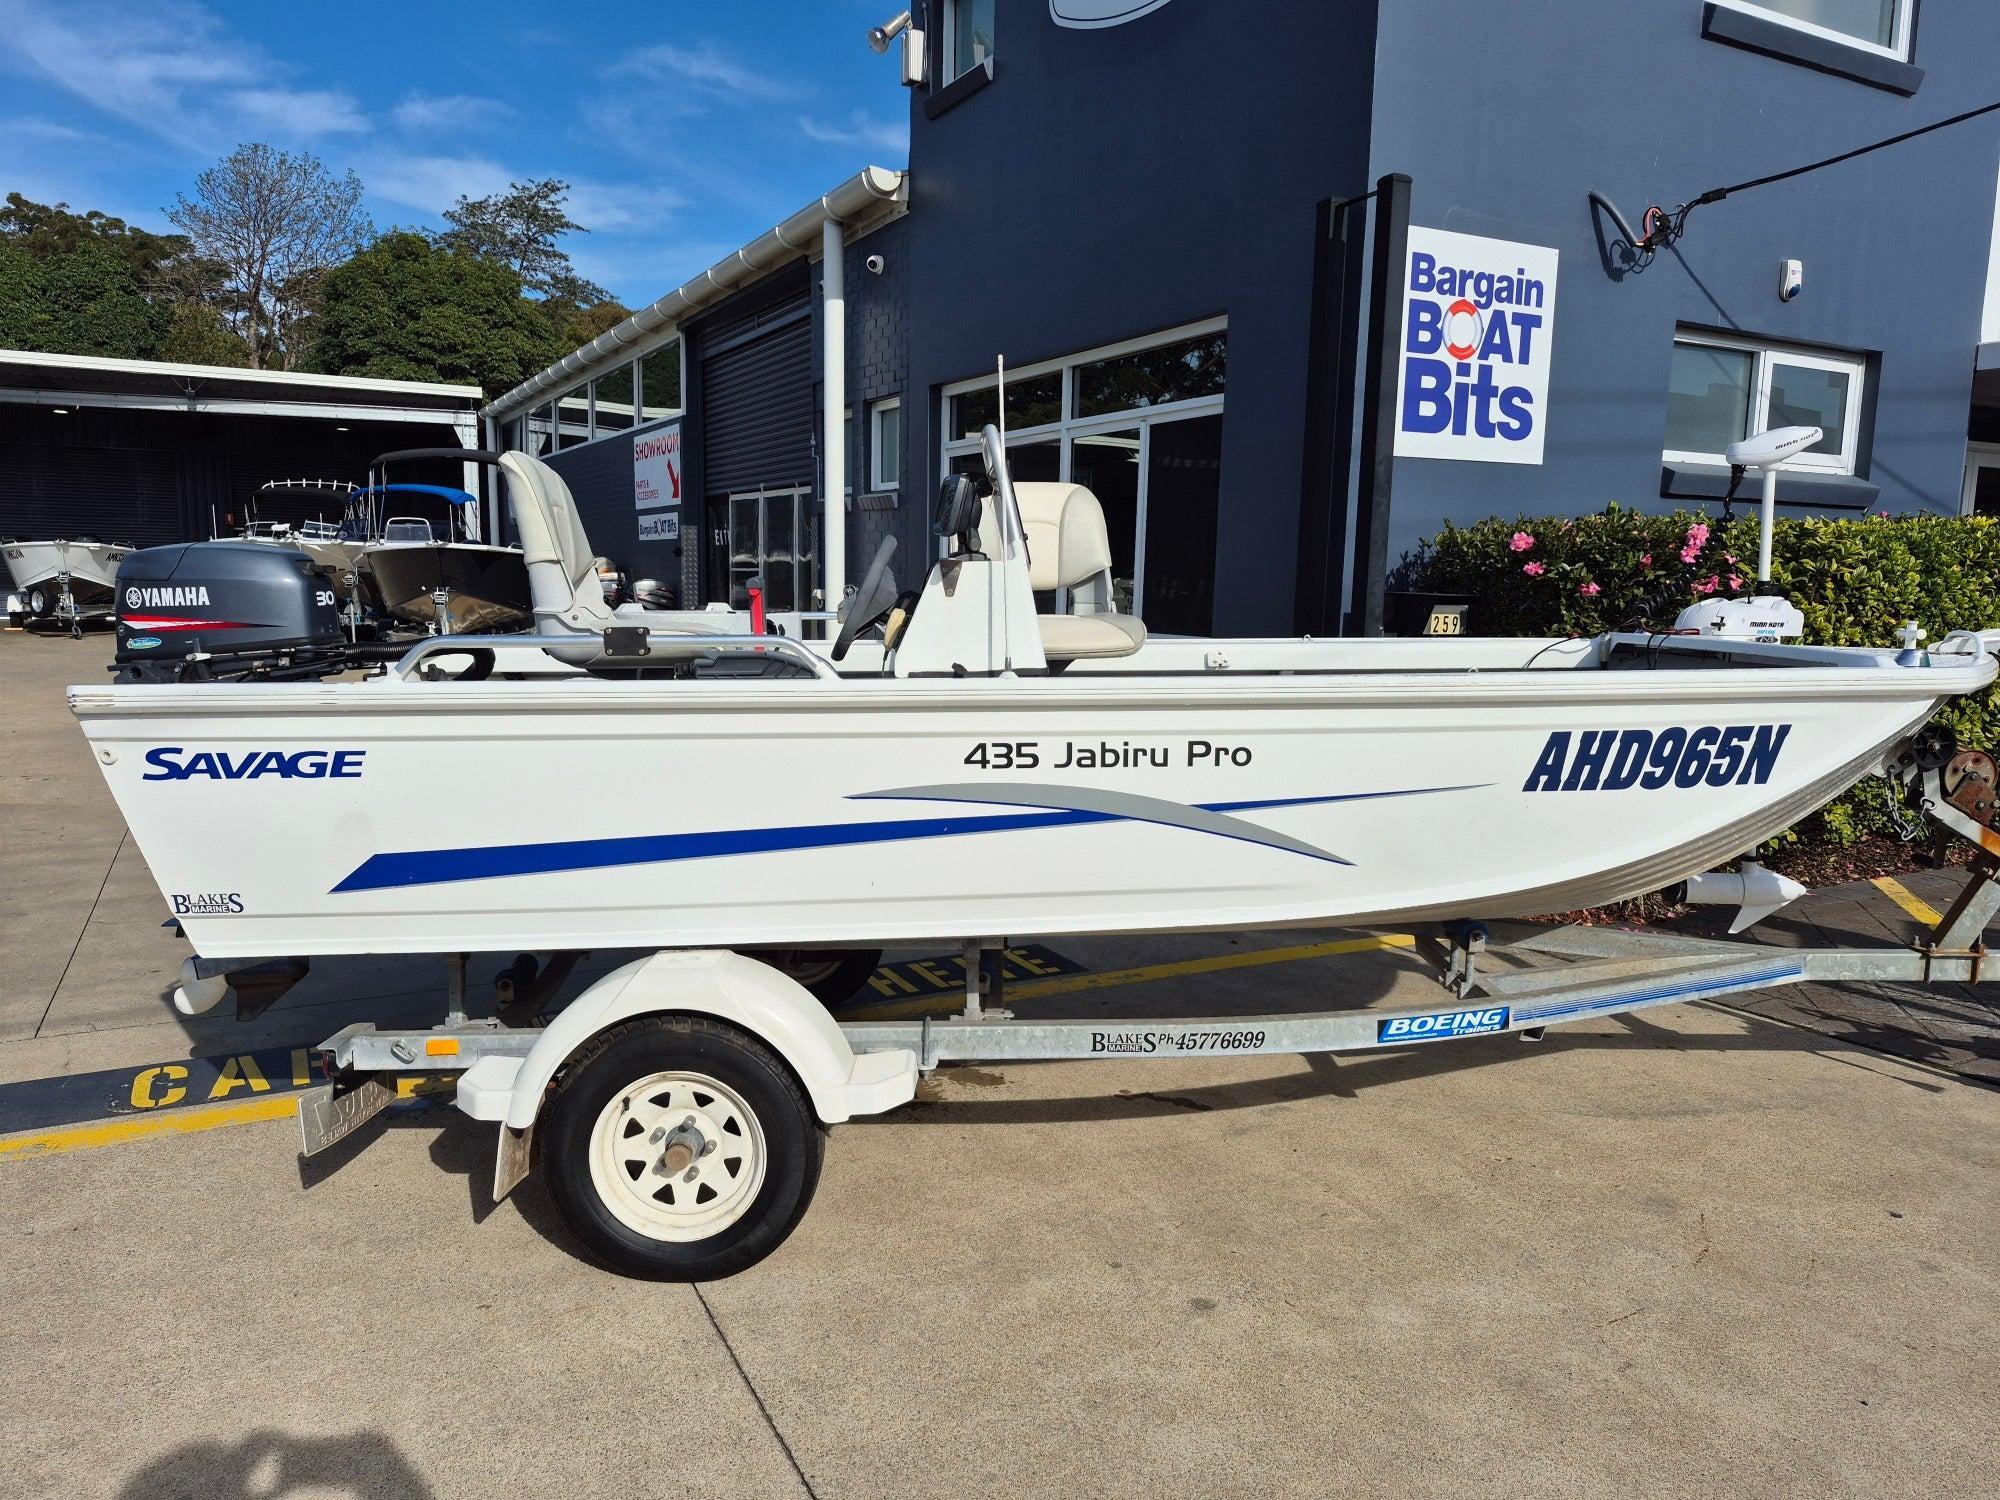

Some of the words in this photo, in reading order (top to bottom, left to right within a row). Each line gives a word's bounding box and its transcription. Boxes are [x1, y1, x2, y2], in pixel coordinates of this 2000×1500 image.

[1410, 251, 1544, 310] Bargain
[1406, 298, 1543, 365] BOAT
[1402, 356, 1534, 441] Bits
[635, 433, 680, 462] SHOWROOM
[141, 586, 211, 607] YAMAHA
[315, 590, 335, 606] 30
[1432, 615, 1459, 633] 259
[142, 747, 367, 781] SAVAGE
[964, 742, 1040, 769] 435
[1053, 741, 1169, 768] Jabiru
[1187, 740, 1253, 767] Pro
[1521, 723, 1792, 792] AHD965N
[171, 893, 244, 914] BLAKES
[191, 904, 230, 913] MARINE
[1387, 1009, 1503, 1035] BOEING
[1451, 1024, 1500, 1035] Trailers
[1091, 1032, 1157, 1053] BLAKES
[1175, 1031, 1266, 1050] 45776699
[1107, 1043, 1143, 1052] MARINE
